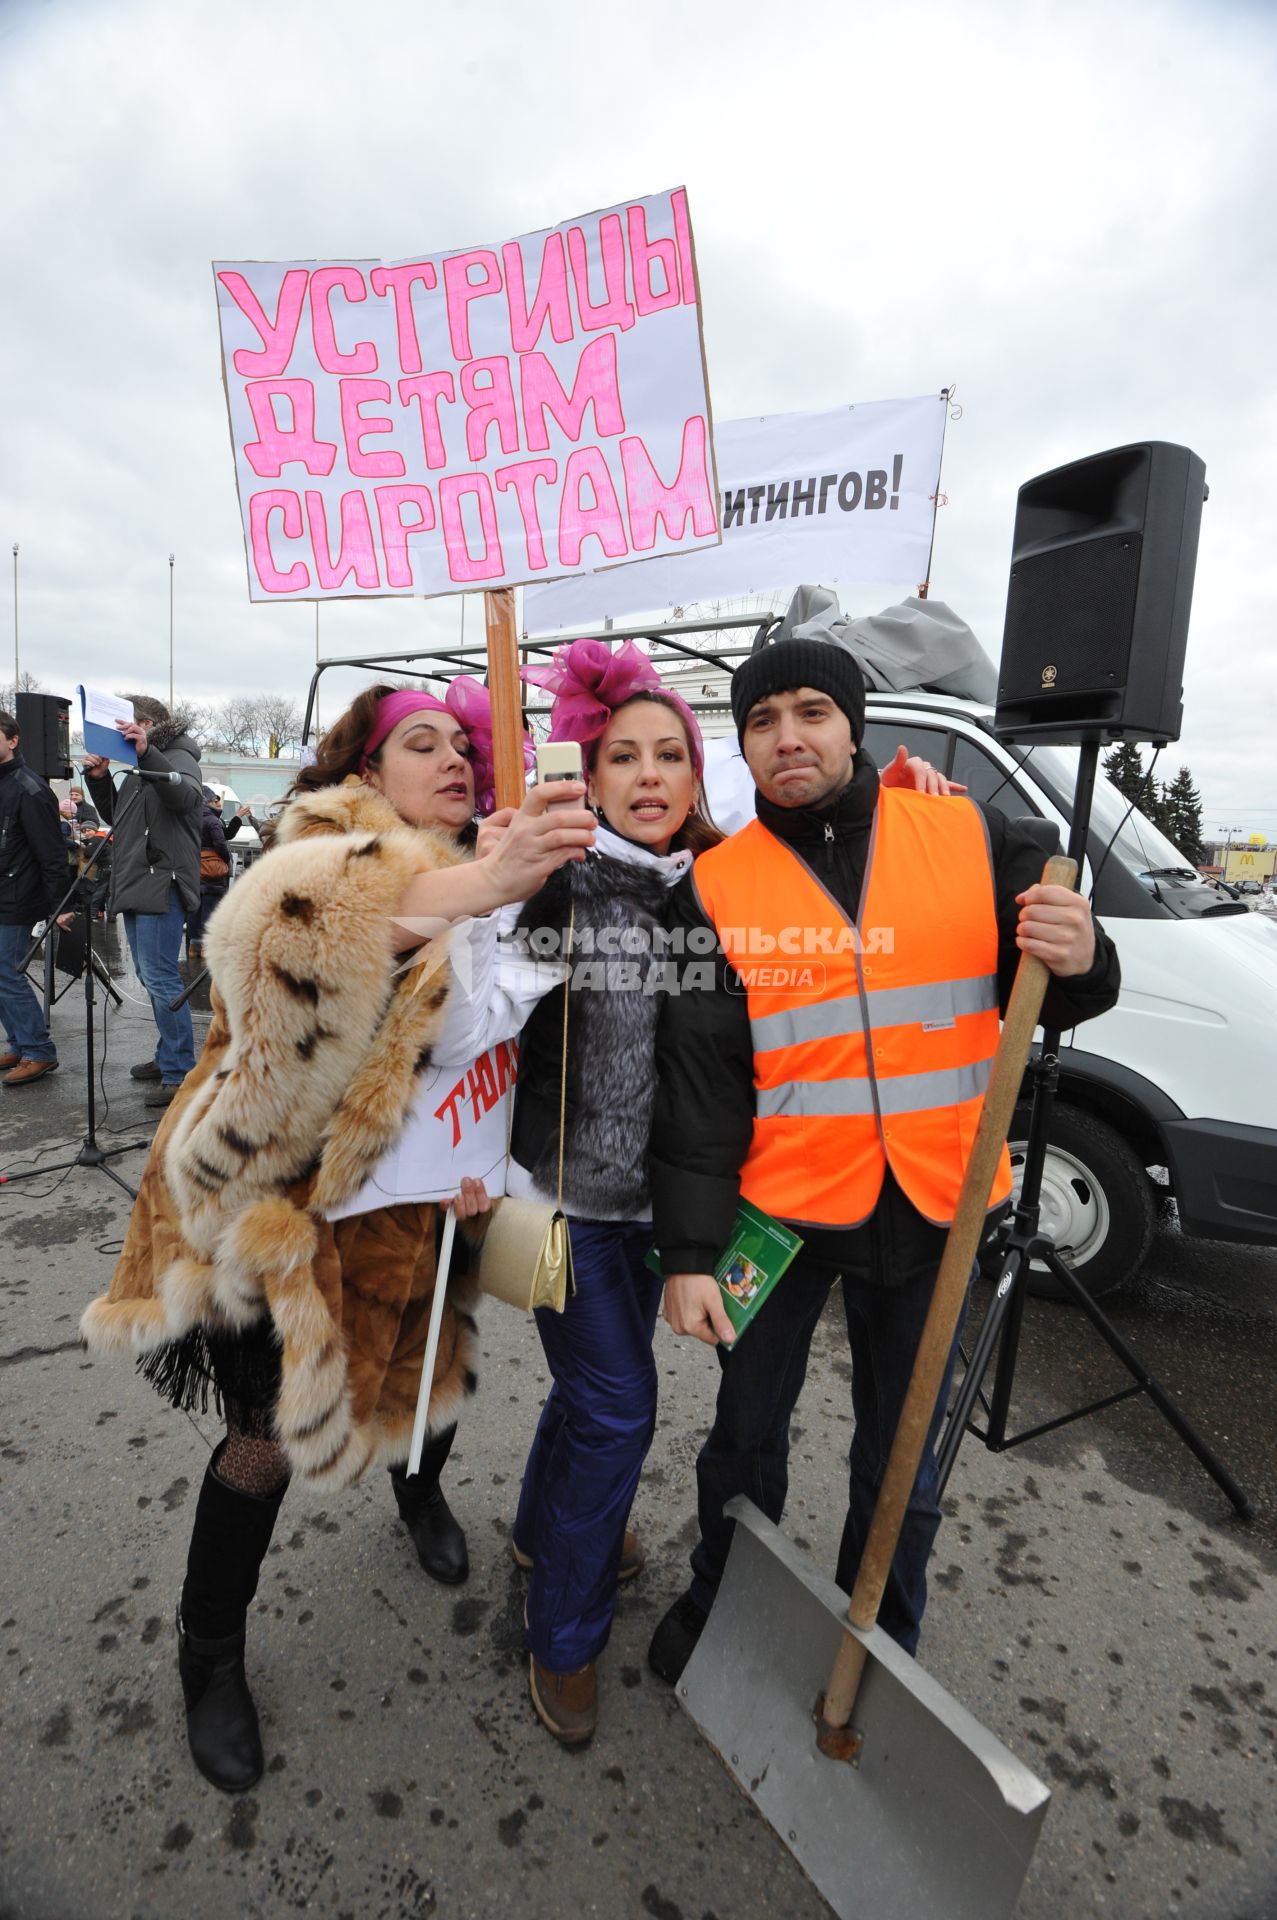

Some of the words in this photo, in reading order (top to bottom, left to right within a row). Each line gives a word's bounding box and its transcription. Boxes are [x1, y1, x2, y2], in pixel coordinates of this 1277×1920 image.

[217, 189, 698, 378] УСТРИЦЫ
[244, 333, 626, 479] ДЕТЯМ
[249, 415, 718, 593] СИРОТАМ
[720, 454, 904, 529] ИТИНГОВ!
